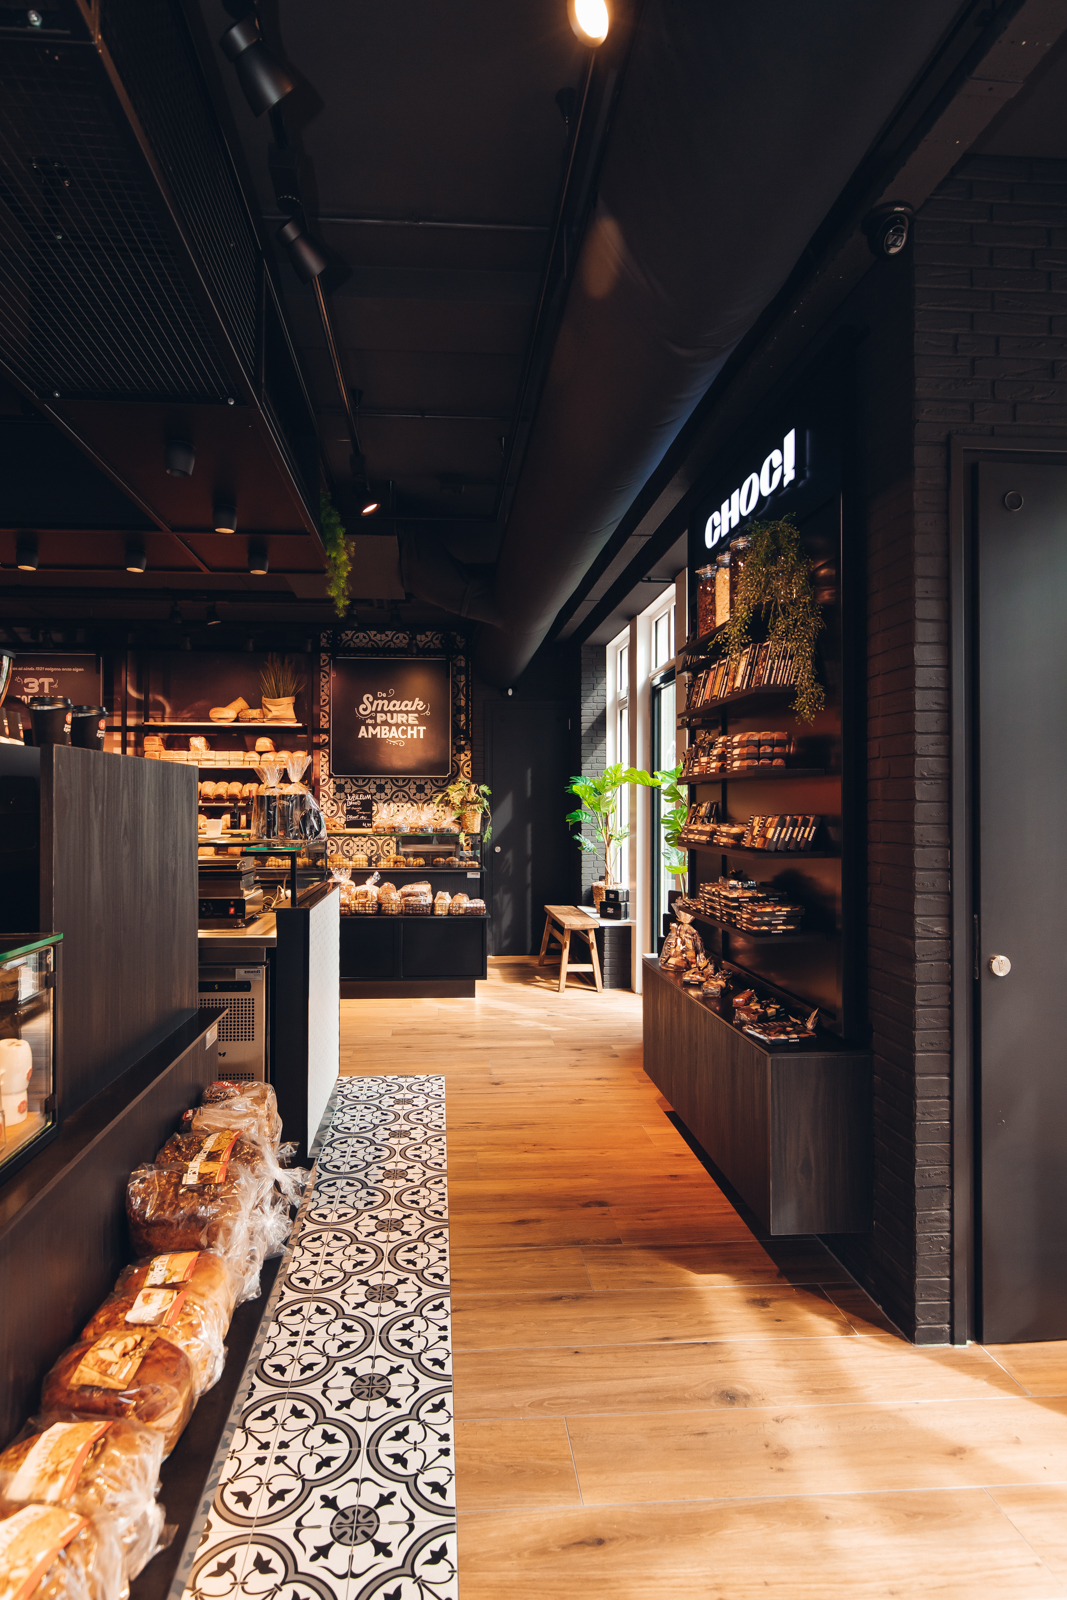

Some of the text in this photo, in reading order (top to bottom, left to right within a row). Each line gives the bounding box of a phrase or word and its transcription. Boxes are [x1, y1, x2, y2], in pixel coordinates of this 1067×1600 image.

[704, 427, 796, 549] CHOC!
[358, 693, 426, 715] Smaak
[376, 713, 419, 724] PURE
[357, 725, 427, 739] AMBACHT
